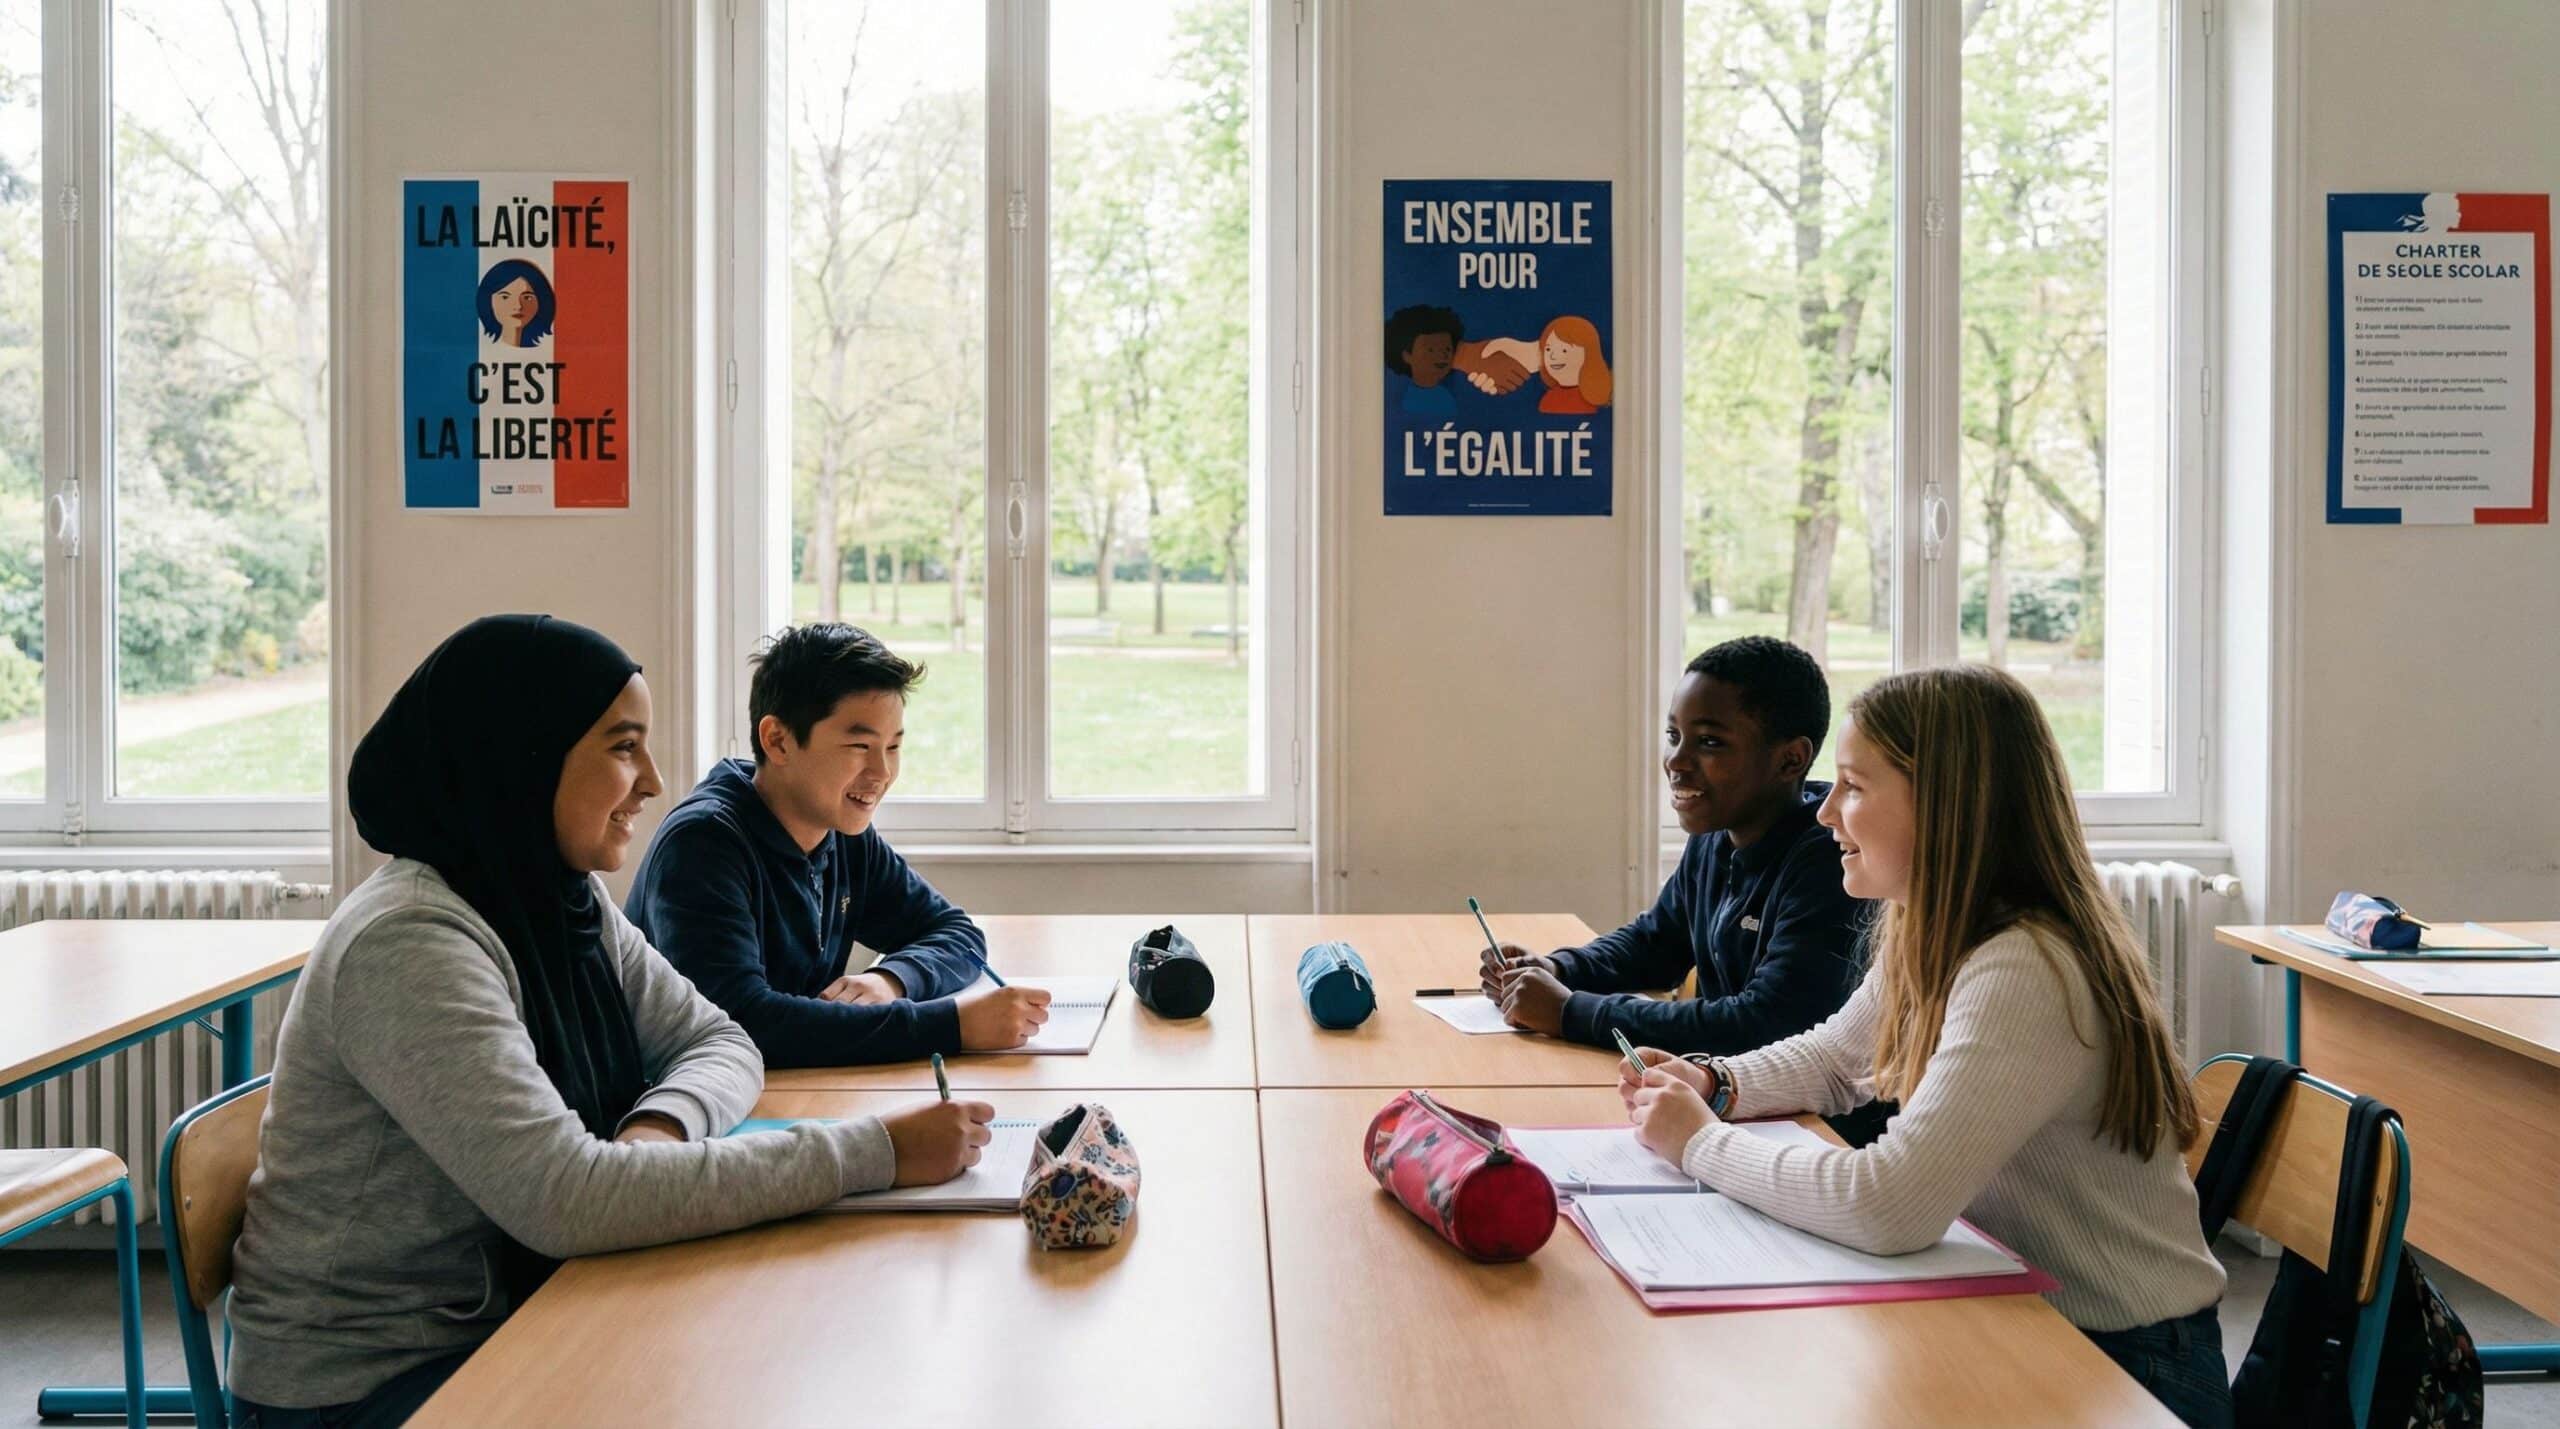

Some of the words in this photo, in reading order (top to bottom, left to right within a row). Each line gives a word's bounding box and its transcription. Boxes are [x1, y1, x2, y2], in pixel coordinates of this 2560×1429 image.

[417, 205, 460, 248] LA
[472, 196, 615, 254] LAÏCITÉ,
[1403, 200, 1593, 245] ENSEMBLE
[1459, 252, 1538, 289] POUR
[2358, 264, 2381, 278] DE
[2448, 264, 2521, 278] SCOLAR
[2395, 244, 2481, 259] CHARTER
[467, 362, 567, 405] C’EST
[417, 417, 461, 460] LA
[472, 408, 617, 461] LIBERTÉ
[1404, 422, 1593, 477] L’ÉGALITÉ
